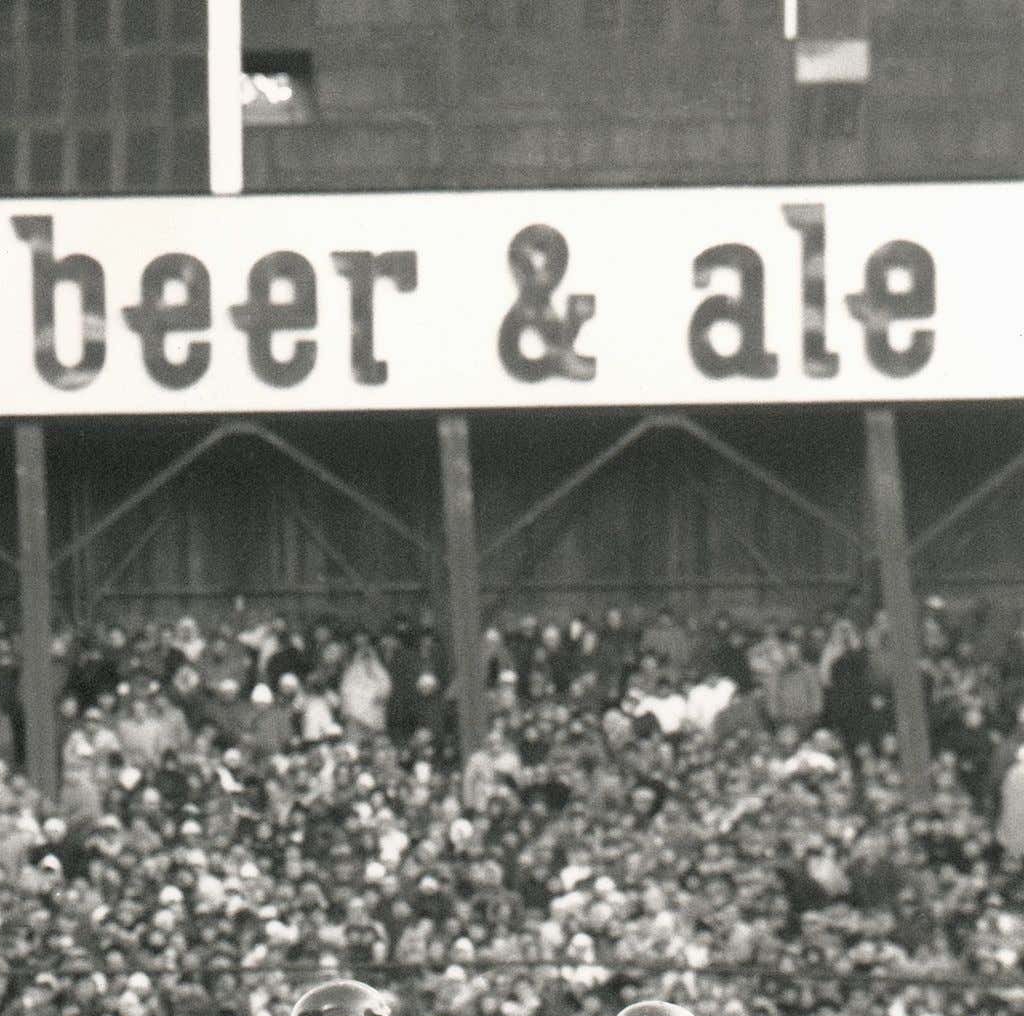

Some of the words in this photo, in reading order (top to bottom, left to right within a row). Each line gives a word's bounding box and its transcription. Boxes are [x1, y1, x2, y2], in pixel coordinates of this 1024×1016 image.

[10, 214, 418, 391] beer
[498, 223, 596, 384] &
[688, 202, 937, 381] ale
